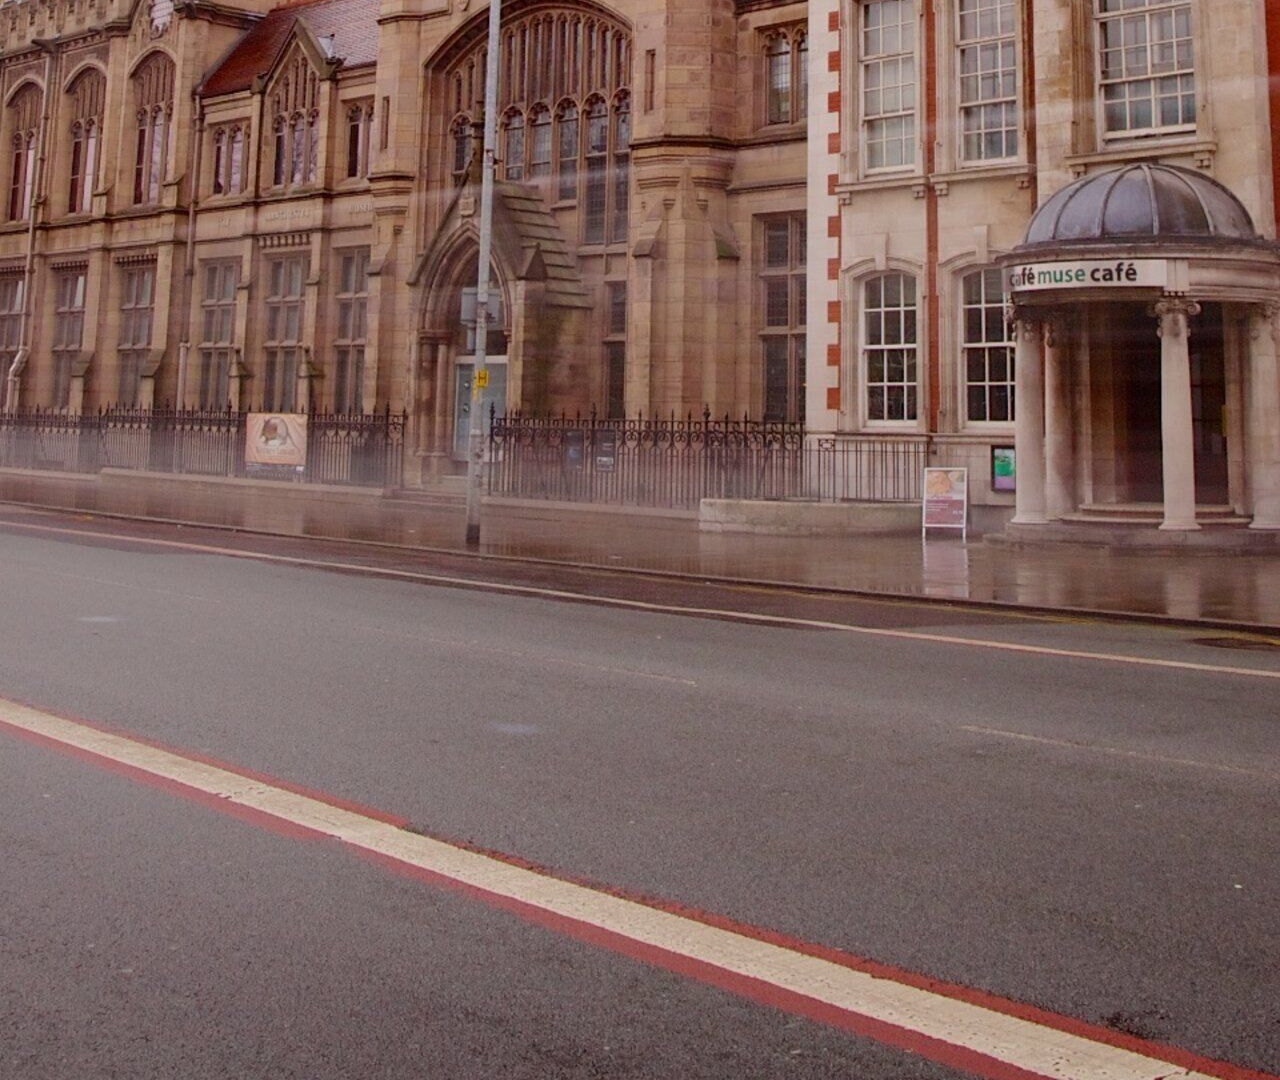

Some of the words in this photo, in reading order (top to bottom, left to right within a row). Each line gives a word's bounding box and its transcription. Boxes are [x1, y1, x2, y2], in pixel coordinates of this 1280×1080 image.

[1009, 267, 1035, 286] café
[1038, 268, 1086, 284] muse
[1090, 262, 1137, 281] café
